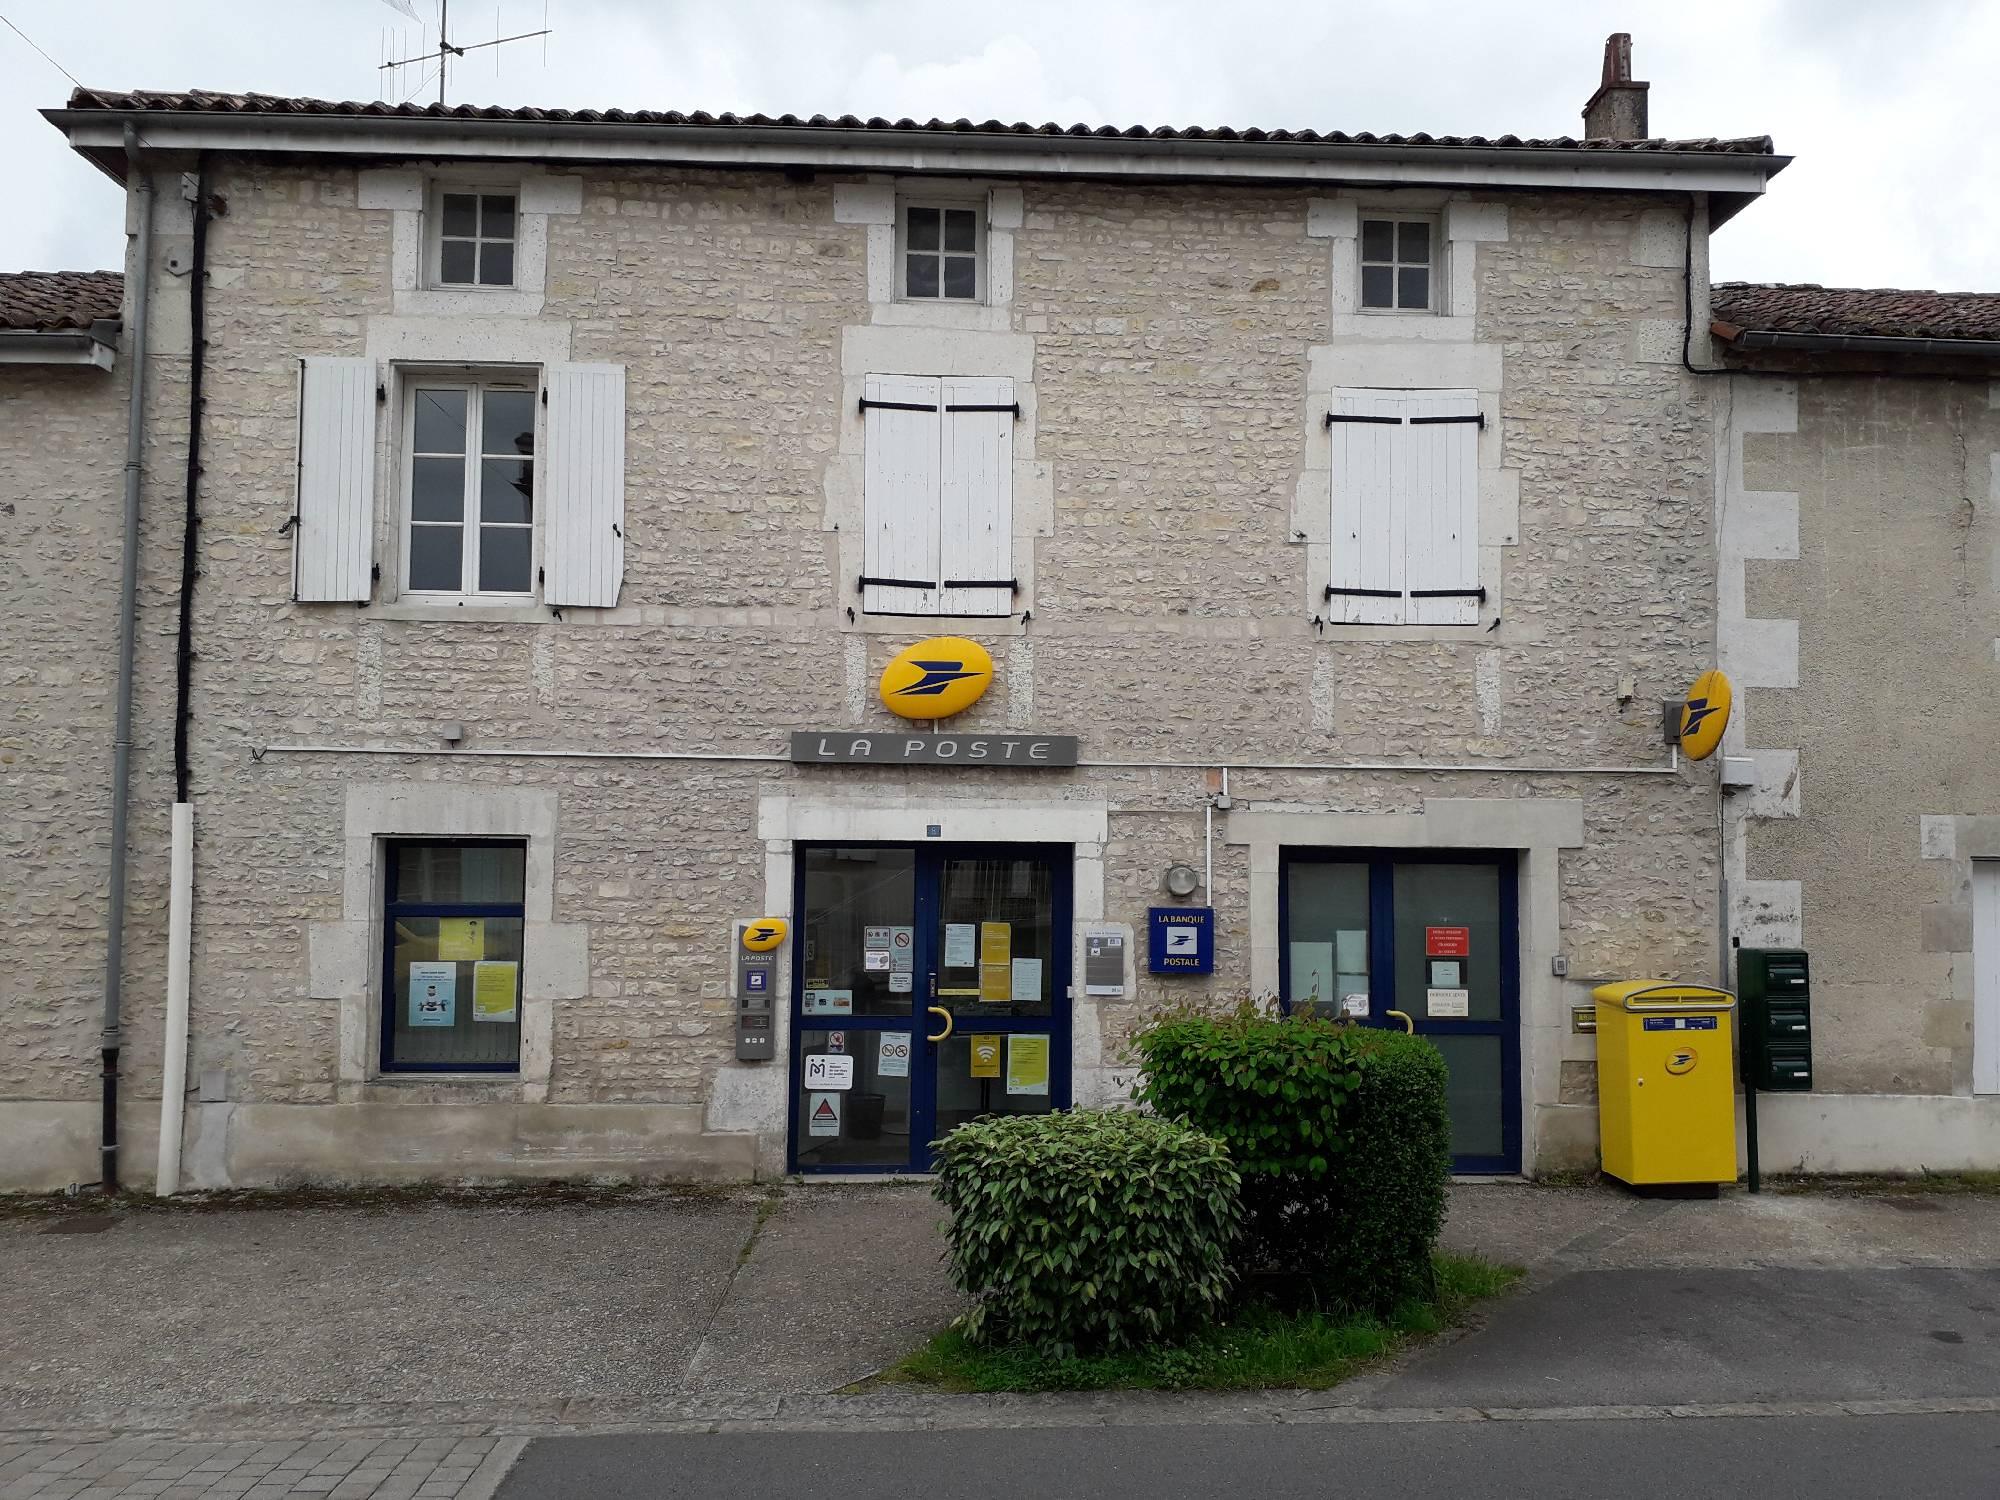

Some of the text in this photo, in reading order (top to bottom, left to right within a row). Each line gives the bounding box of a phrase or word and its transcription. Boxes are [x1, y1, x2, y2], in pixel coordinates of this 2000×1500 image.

[818, 738, 1052, 760] LA POSTE
[1158, 915, 1205, 924] LA BANQUE
[1163, 958, 1200, 966] POSTALE
